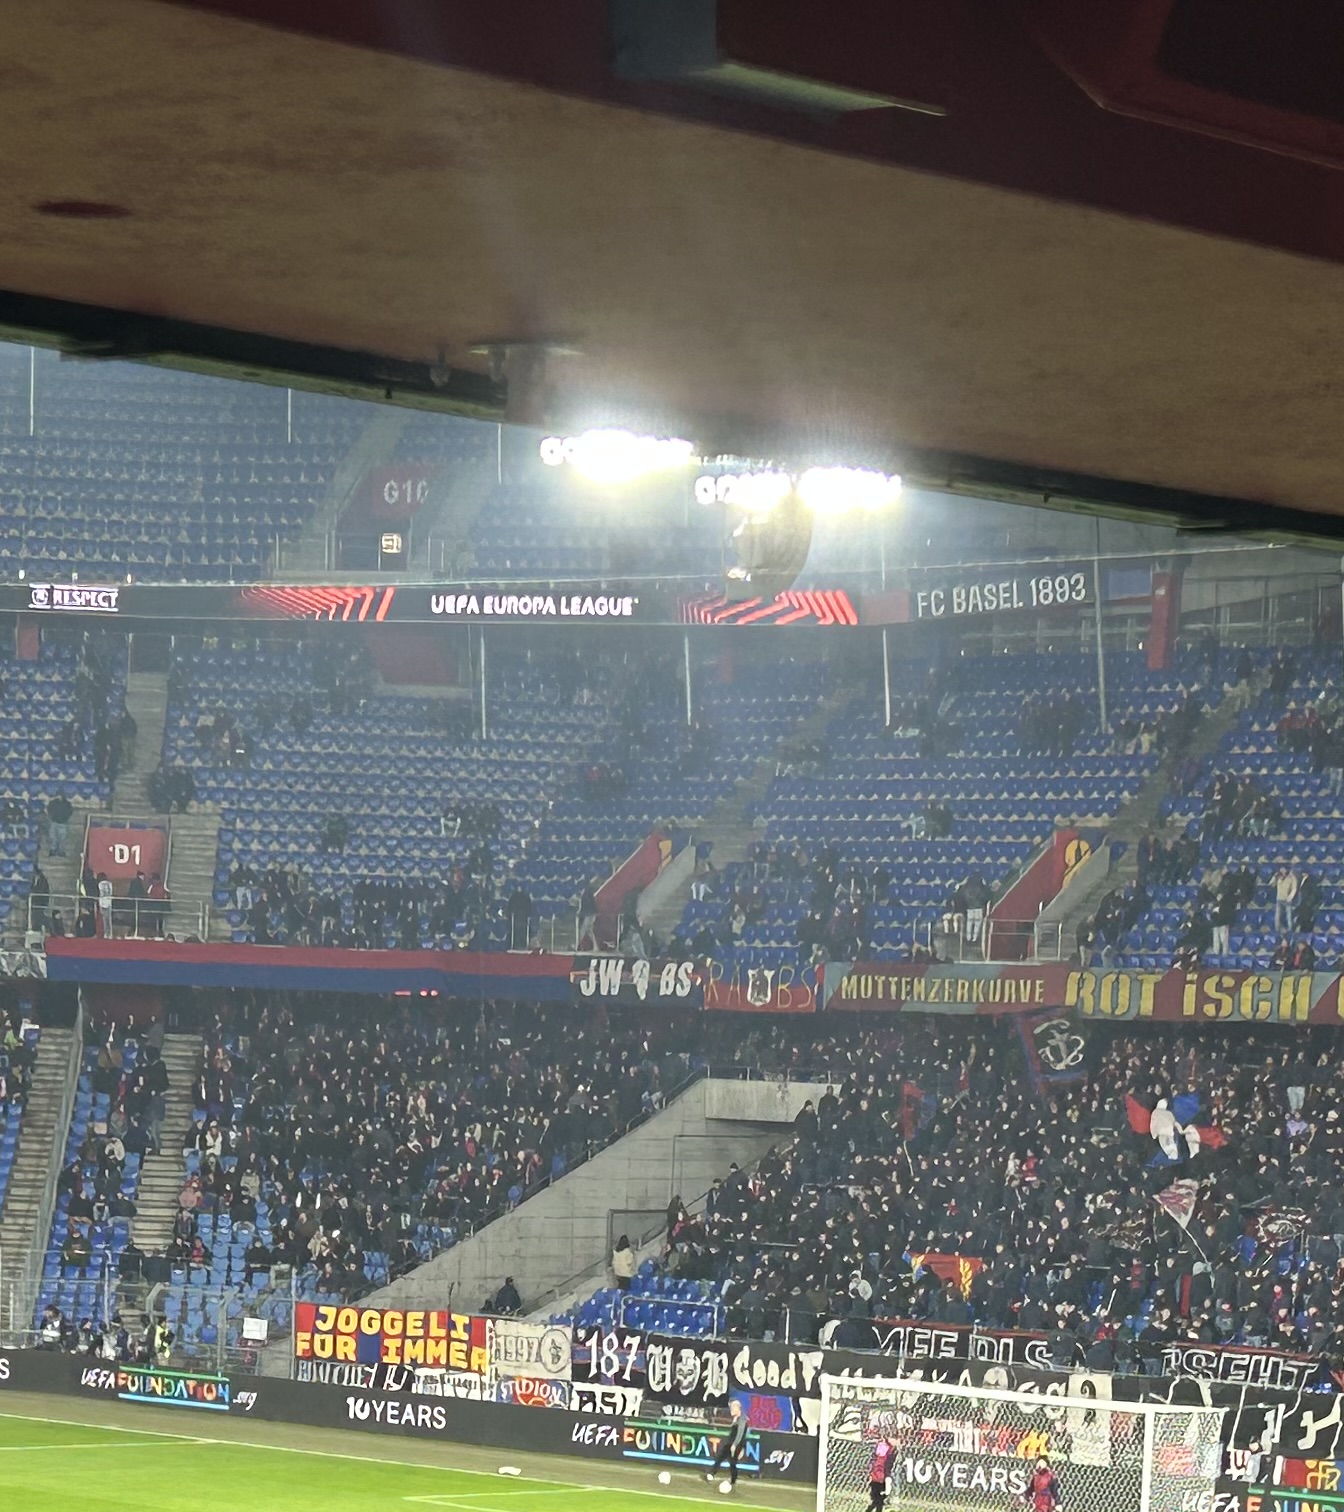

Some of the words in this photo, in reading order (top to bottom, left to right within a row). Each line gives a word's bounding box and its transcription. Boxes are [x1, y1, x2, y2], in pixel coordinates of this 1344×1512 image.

[52, 589, 119, 608] RESPECT
[430, 594, 480, 615] UEFA
[483, 594, 557, 616] EUROPA
[559, 595, 633, 617] LEAGUE
[917, 589, 945, 618] FC
[952, 578, 1024, 615] BASEL
[1029, 572, 1086, 607] 1893
[113, 843, 142, 866] D1
[1064, 970, 1162, 1018] ROT
[314, 1305, 471, 1341] JOGGELI
[382, 1337, 488, 1373] IMMER
[497, 1334, 539, 1363] 1997
[584, 1329, 641, 1381] 187
[81, 1367, 116, 1390] UEFA
[116, 1372, 230, 1404] FOUNDATION
[570, 1422, 621, 1448] UEFA
[622, 1427, 761, 1463] FOUNDATN
